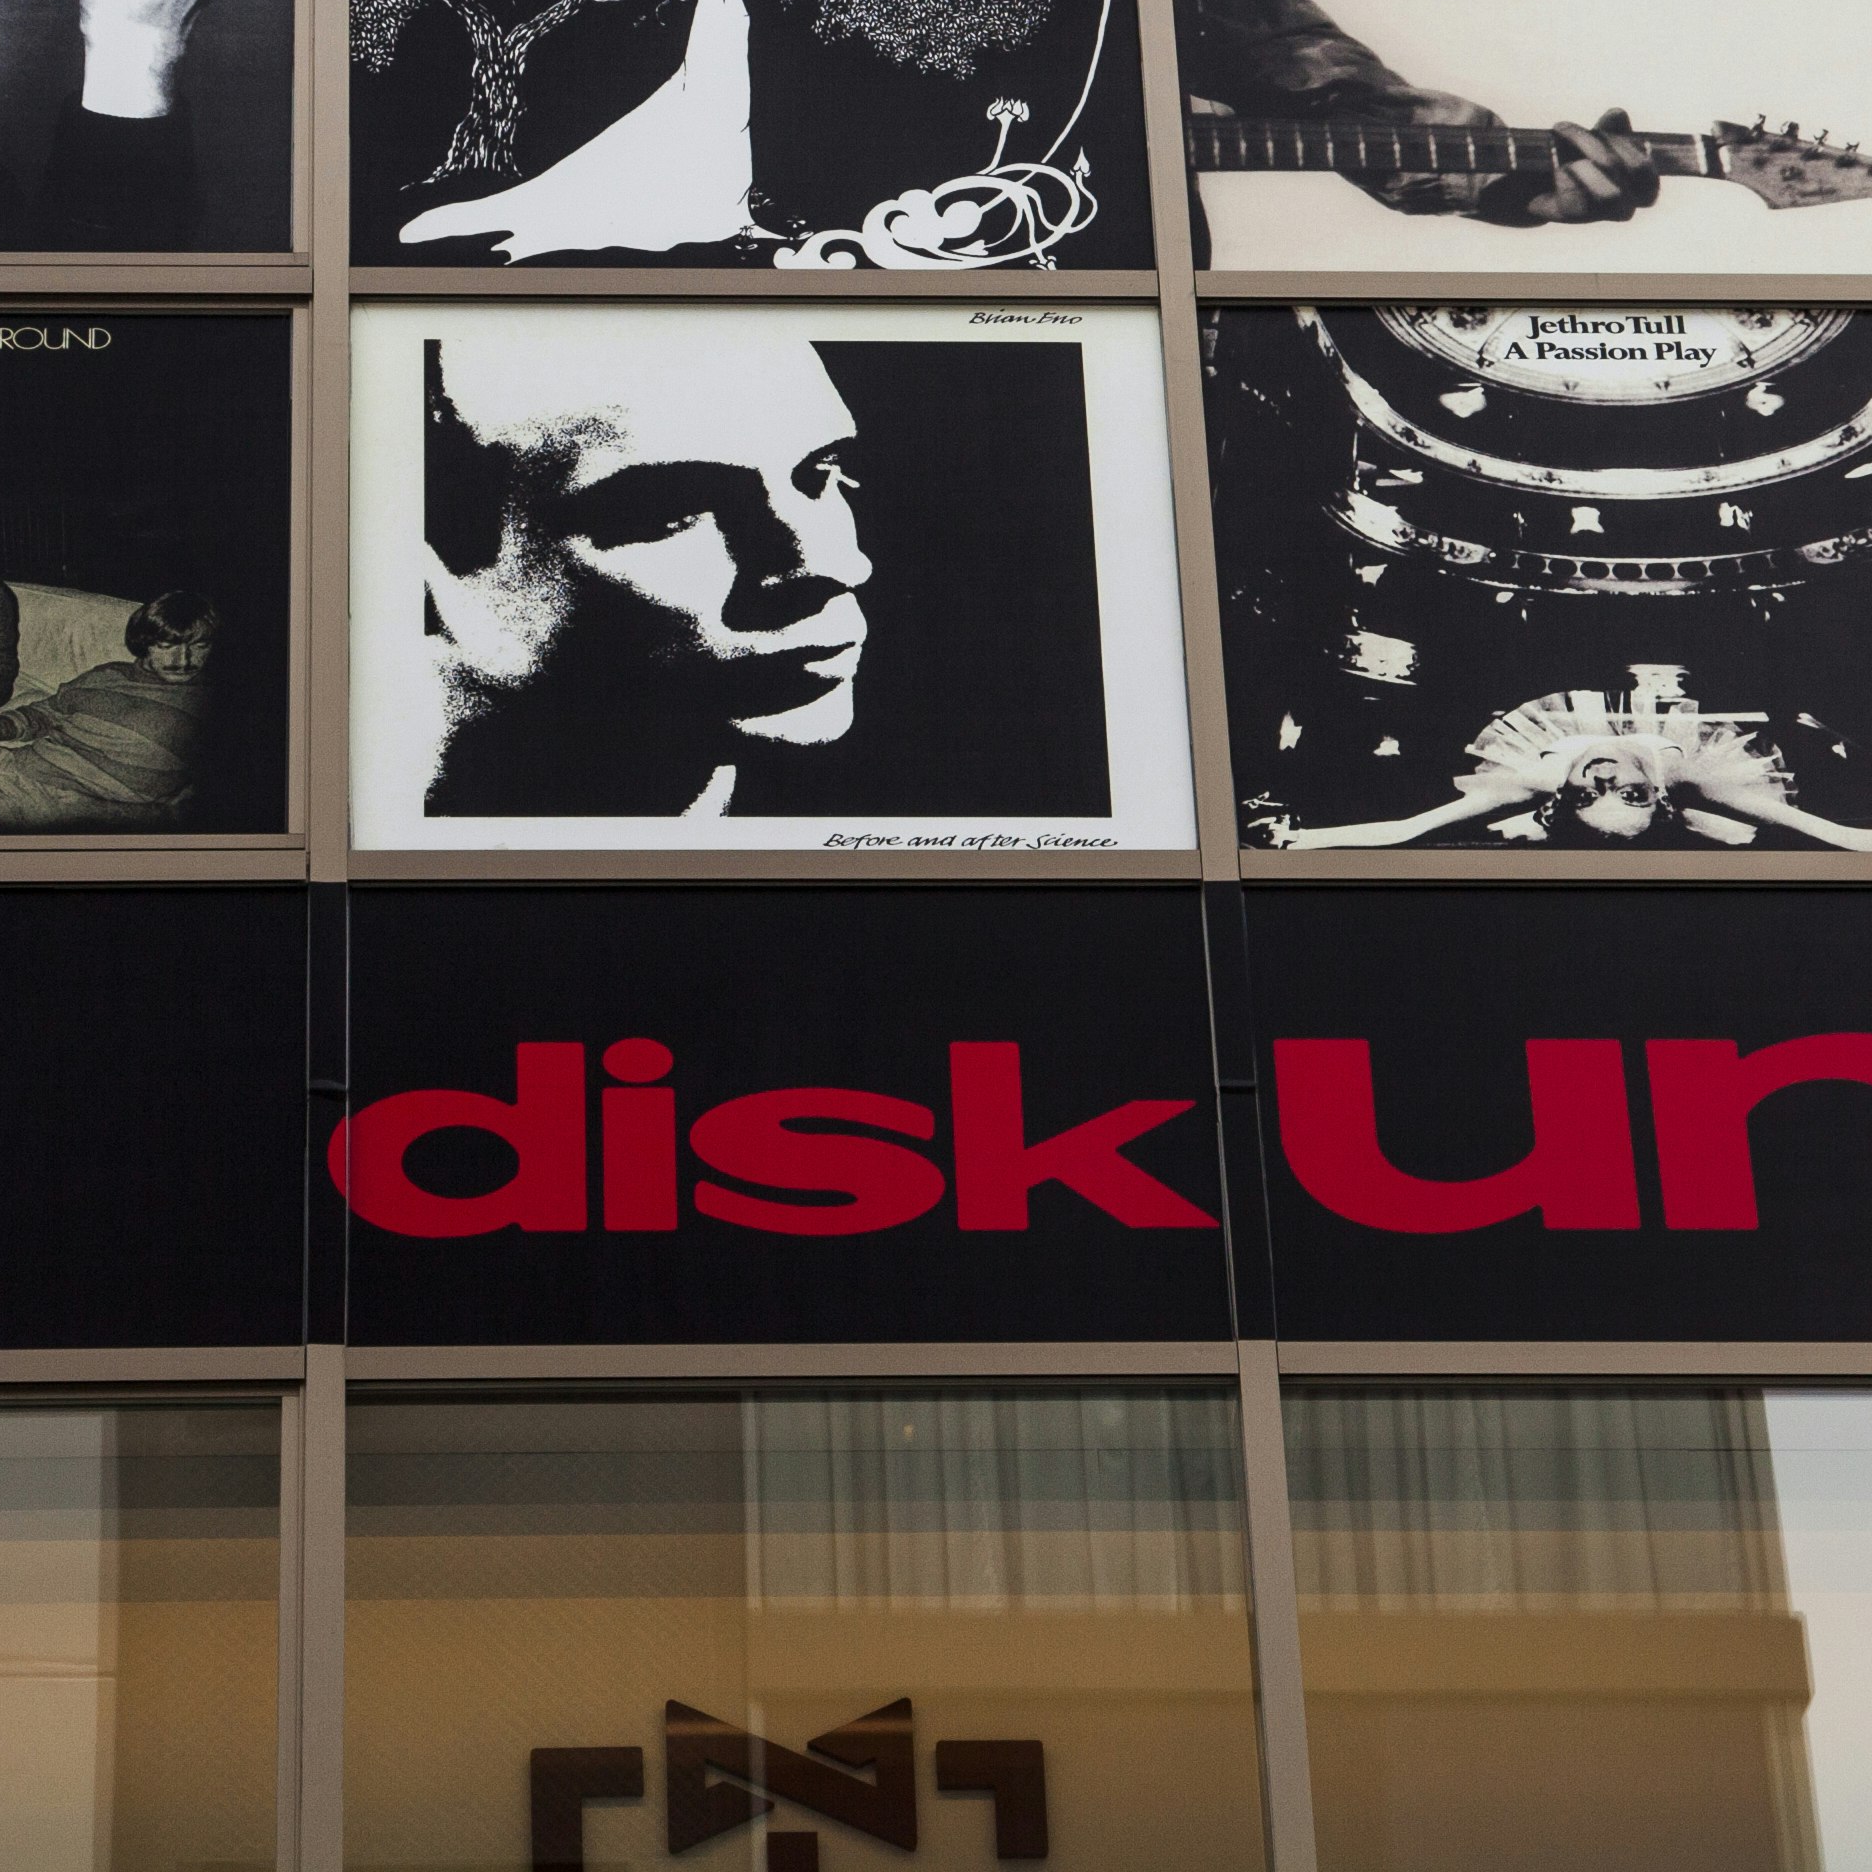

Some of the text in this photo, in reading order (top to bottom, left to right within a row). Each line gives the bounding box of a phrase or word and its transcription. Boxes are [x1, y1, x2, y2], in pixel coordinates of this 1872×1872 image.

[969, 308, 1083, 325] Brian Eno
[1527, 315, 1685, 339] Jethro Tull
[1504, 341, 1716, 368] A Passion Play
[823, 833, 1118, 850] Before and after Science
[328, 1038, 1219, 1238] disk
